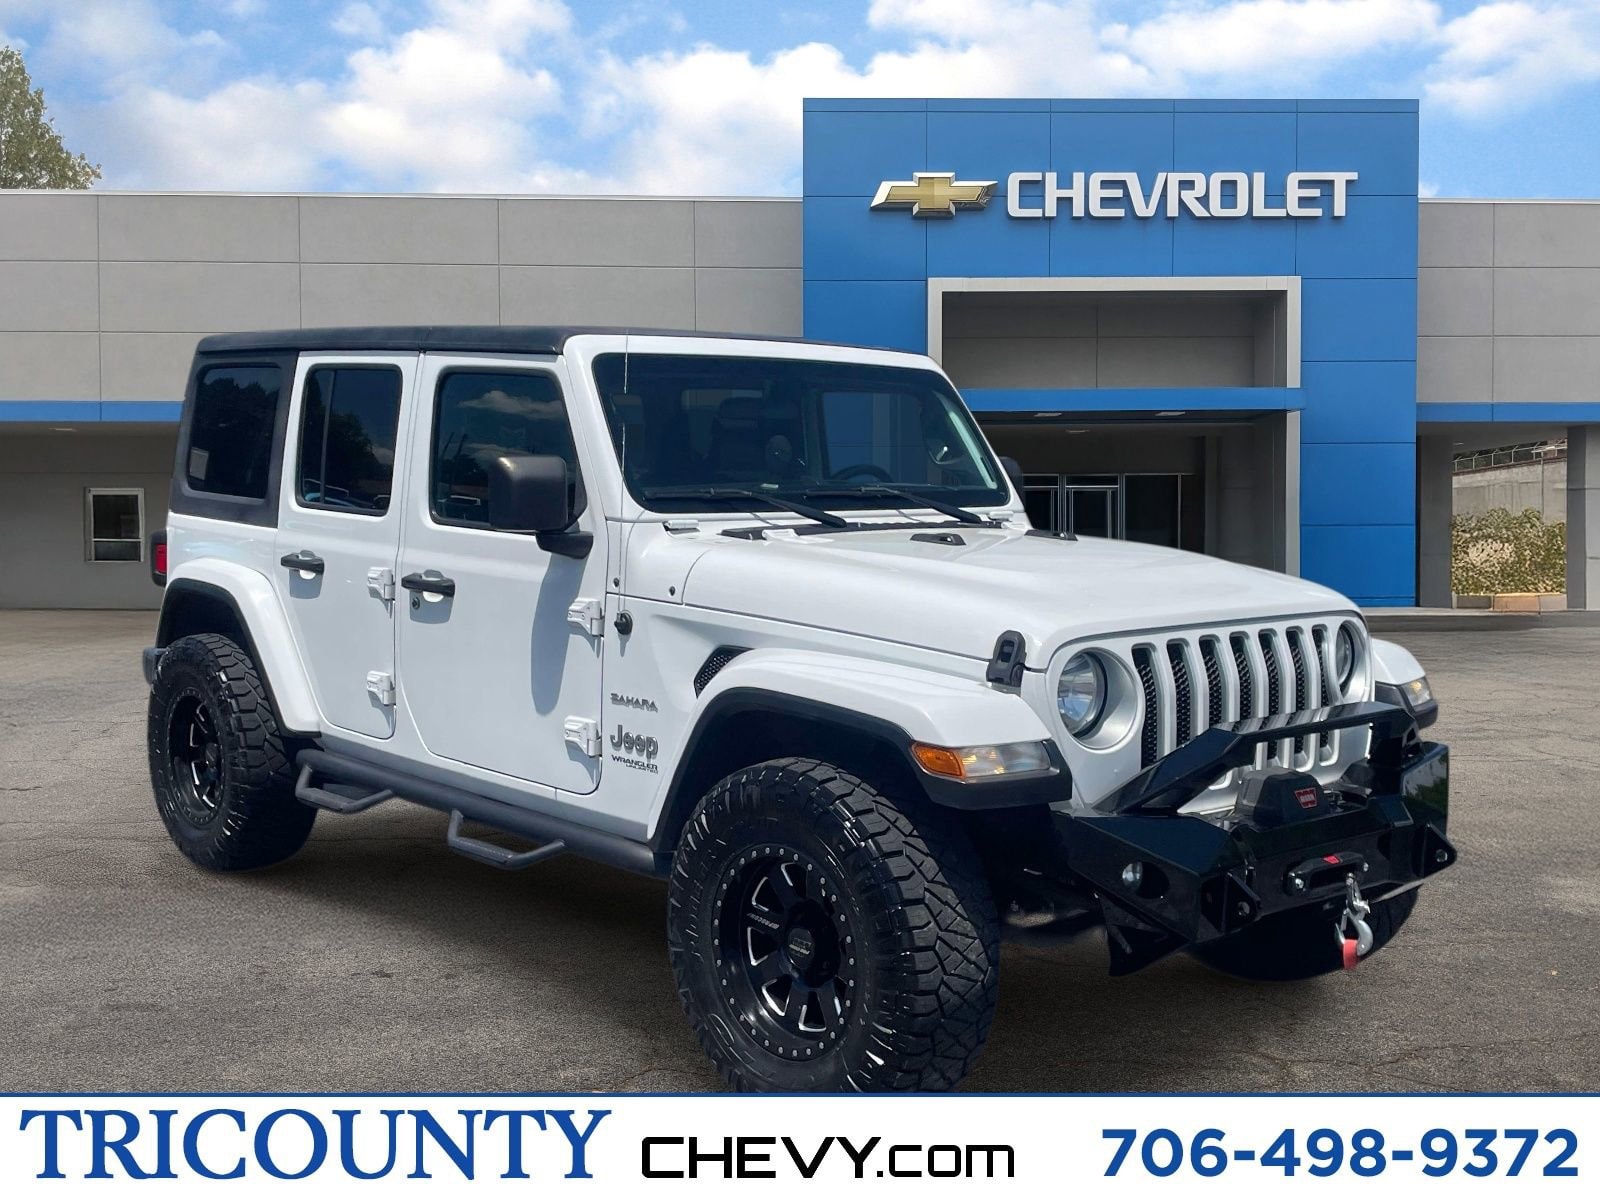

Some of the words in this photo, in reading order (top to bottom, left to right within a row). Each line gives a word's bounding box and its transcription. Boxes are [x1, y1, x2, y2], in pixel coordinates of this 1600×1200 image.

[1007, 171, 1358, 217] CHEVROLET
[610, 692, 658, 712] SAHARA
[609, 724, 659, 760] Jeep
[611, 754, 658, 770] WRANGLER
